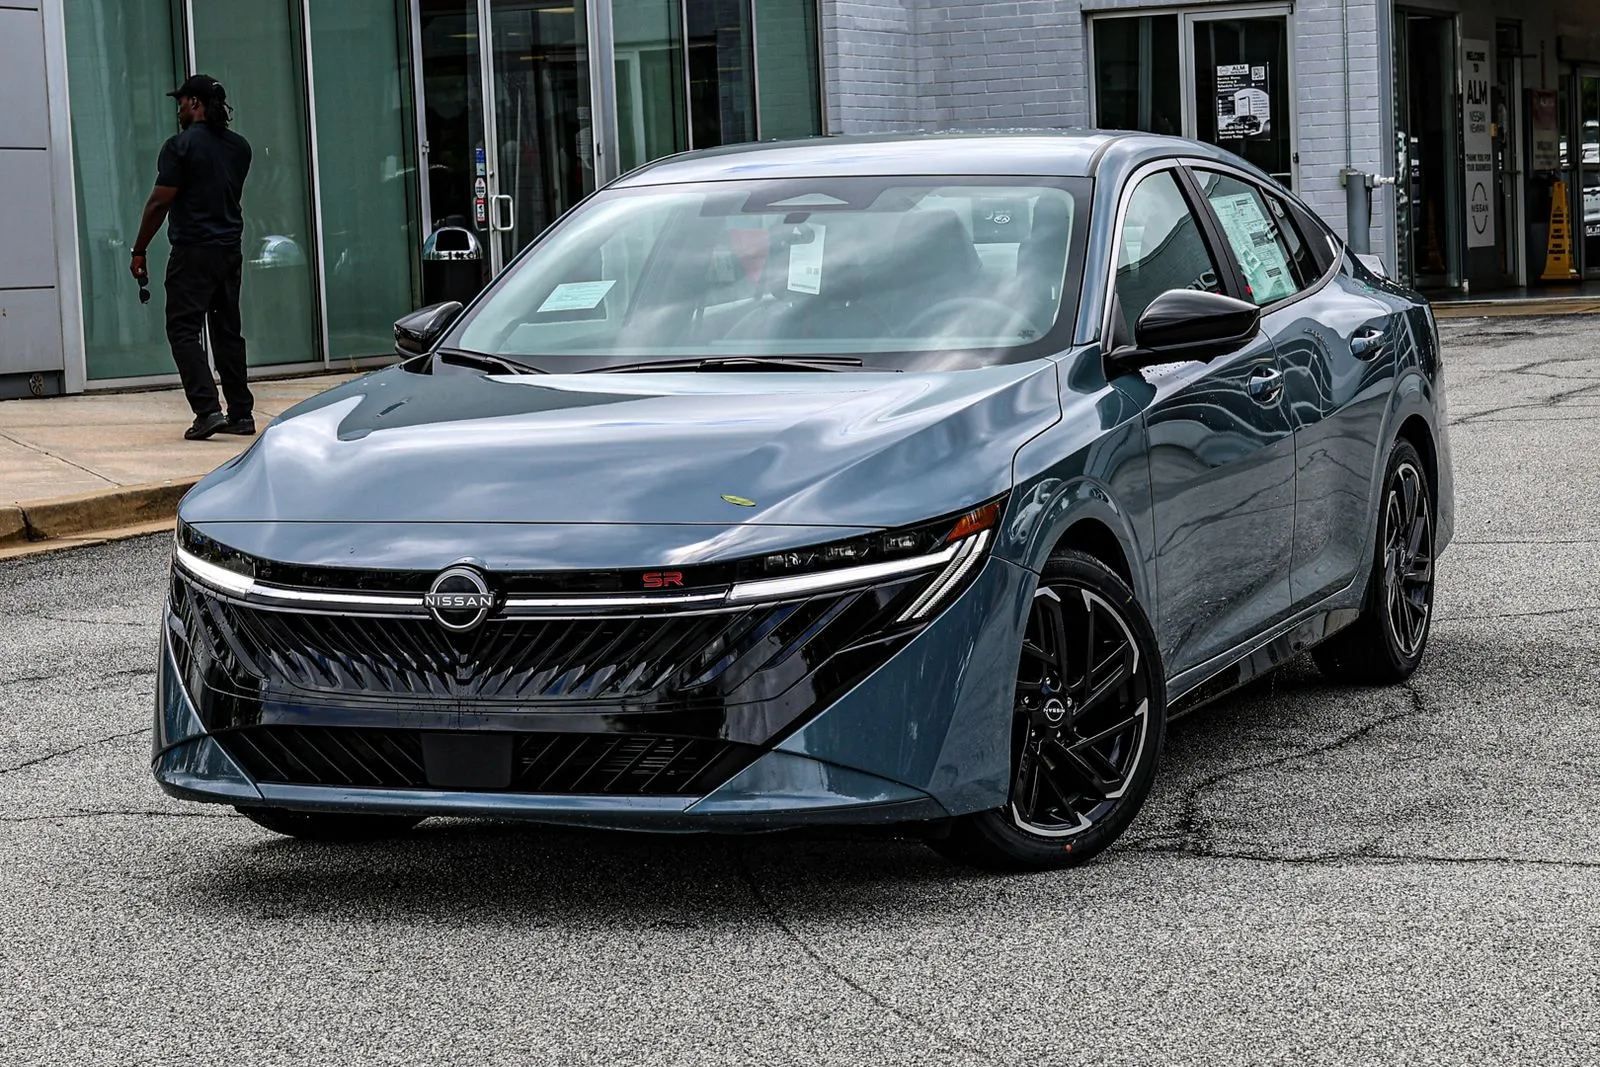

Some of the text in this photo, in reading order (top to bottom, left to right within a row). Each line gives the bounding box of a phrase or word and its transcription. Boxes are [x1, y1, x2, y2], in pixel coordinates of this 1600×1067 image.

[1467, 80, 1488, 105] ALM
[1471, 204, 1489, 213] NISSAN
[643, 571, 684, 588] SR
[425, 595, 494, 608] NISSAN
